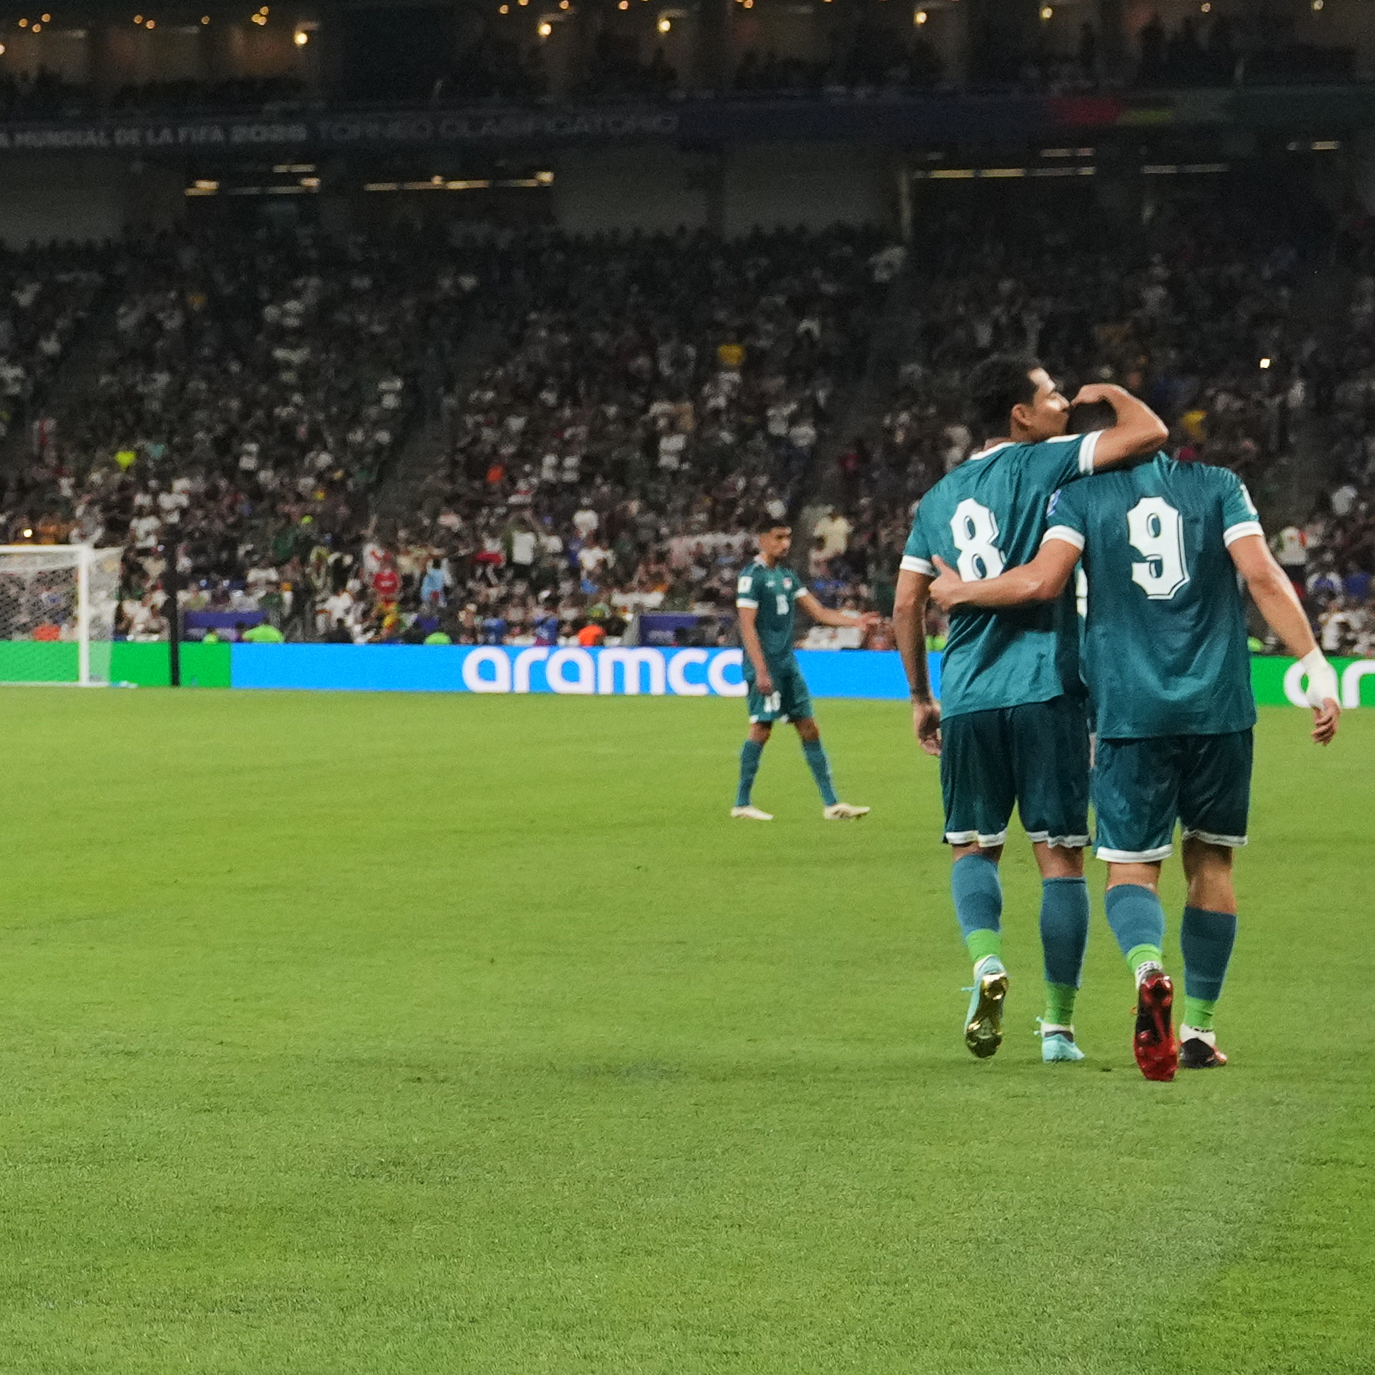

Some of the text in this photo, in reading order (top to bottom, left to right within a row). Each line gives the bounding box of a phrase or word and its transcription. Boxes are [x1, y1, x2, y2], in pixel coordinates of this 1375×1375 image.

[15, 130, 110, 147] MUNDIAL
[113, 128, 140, 145] DE
[145, 127, 174, 145] LA
[178, 126, 225, 143] FIFA
[950, 497, 1007, 584] 8
[1127, 496, 1191, 601] 9
[462, 646, 748, 697] aramco
